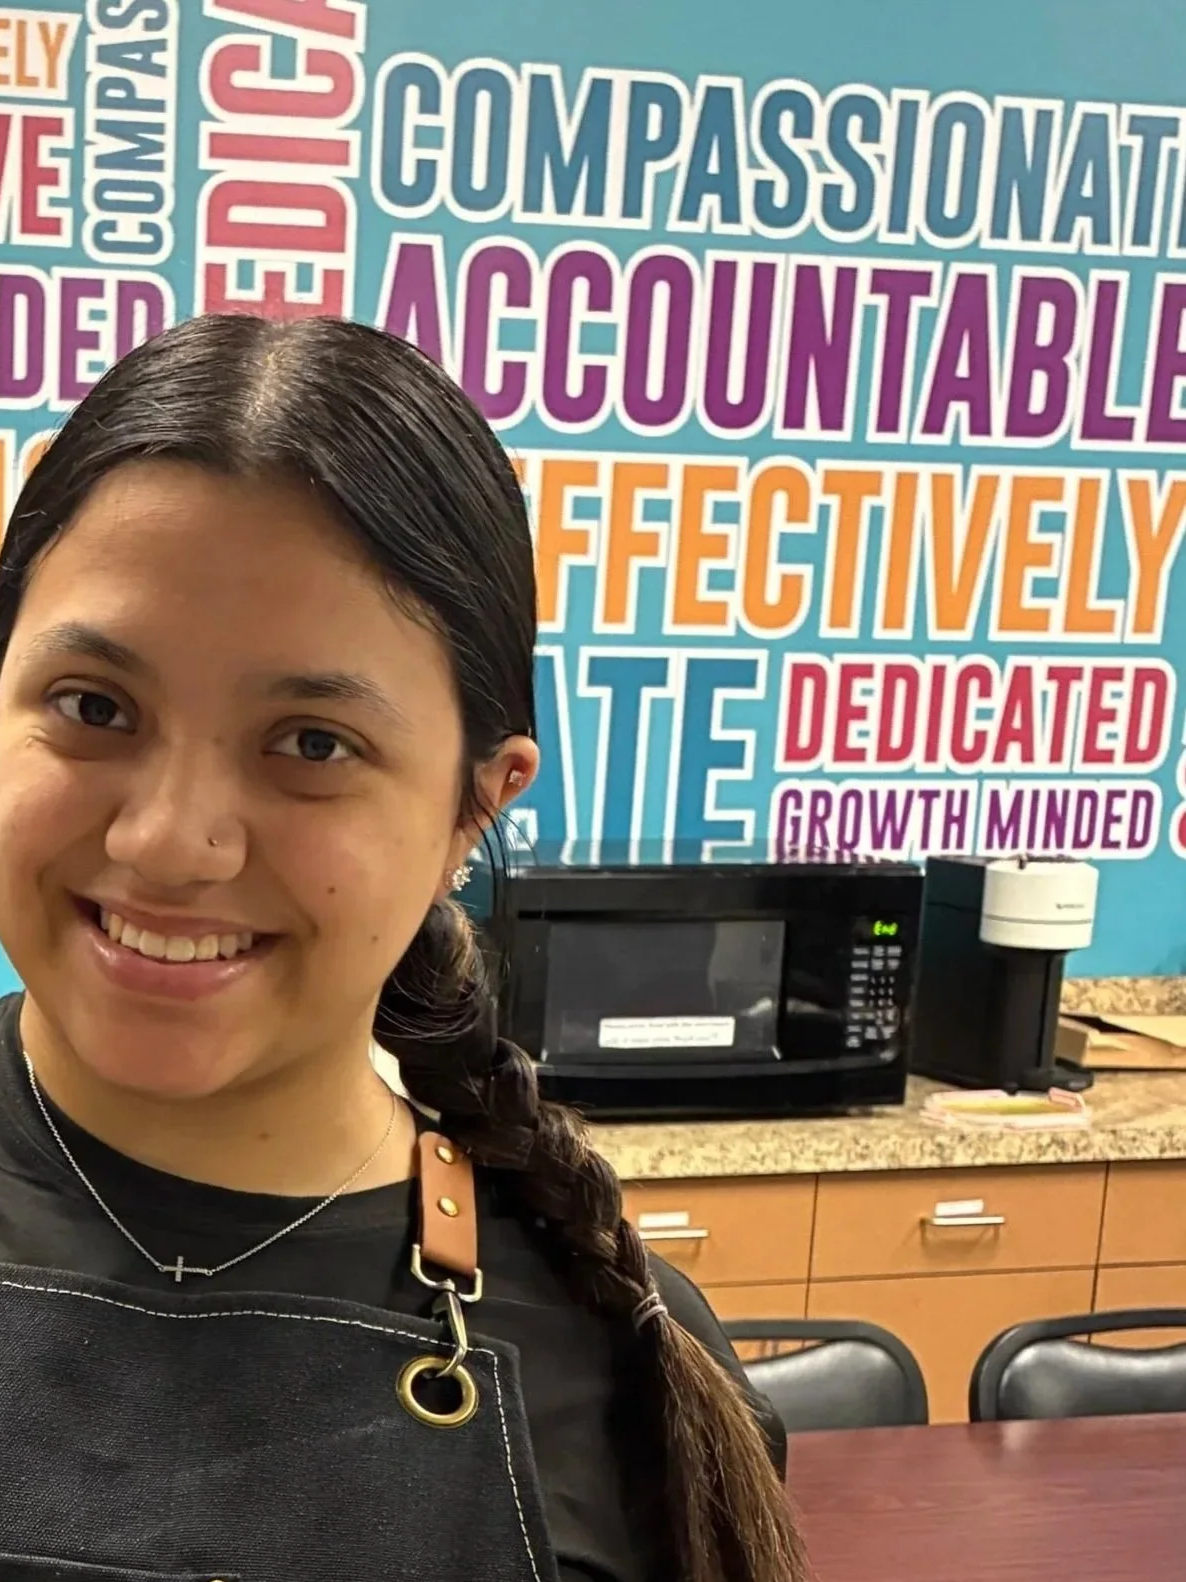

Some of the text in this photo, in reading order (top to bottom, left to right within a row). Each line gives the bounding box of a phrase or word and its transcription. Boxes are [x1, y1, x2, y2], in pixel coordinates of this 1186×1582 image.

[380, 61, 1186, 252] COMPASSIONAT
[511, 457, 1186, 634] FFECTIVELY
[783, 664, 1168, 765] DEDICATED
[777, 788, 969, 852] GROWTH
[985, 788, 1155, 850] MINDED
